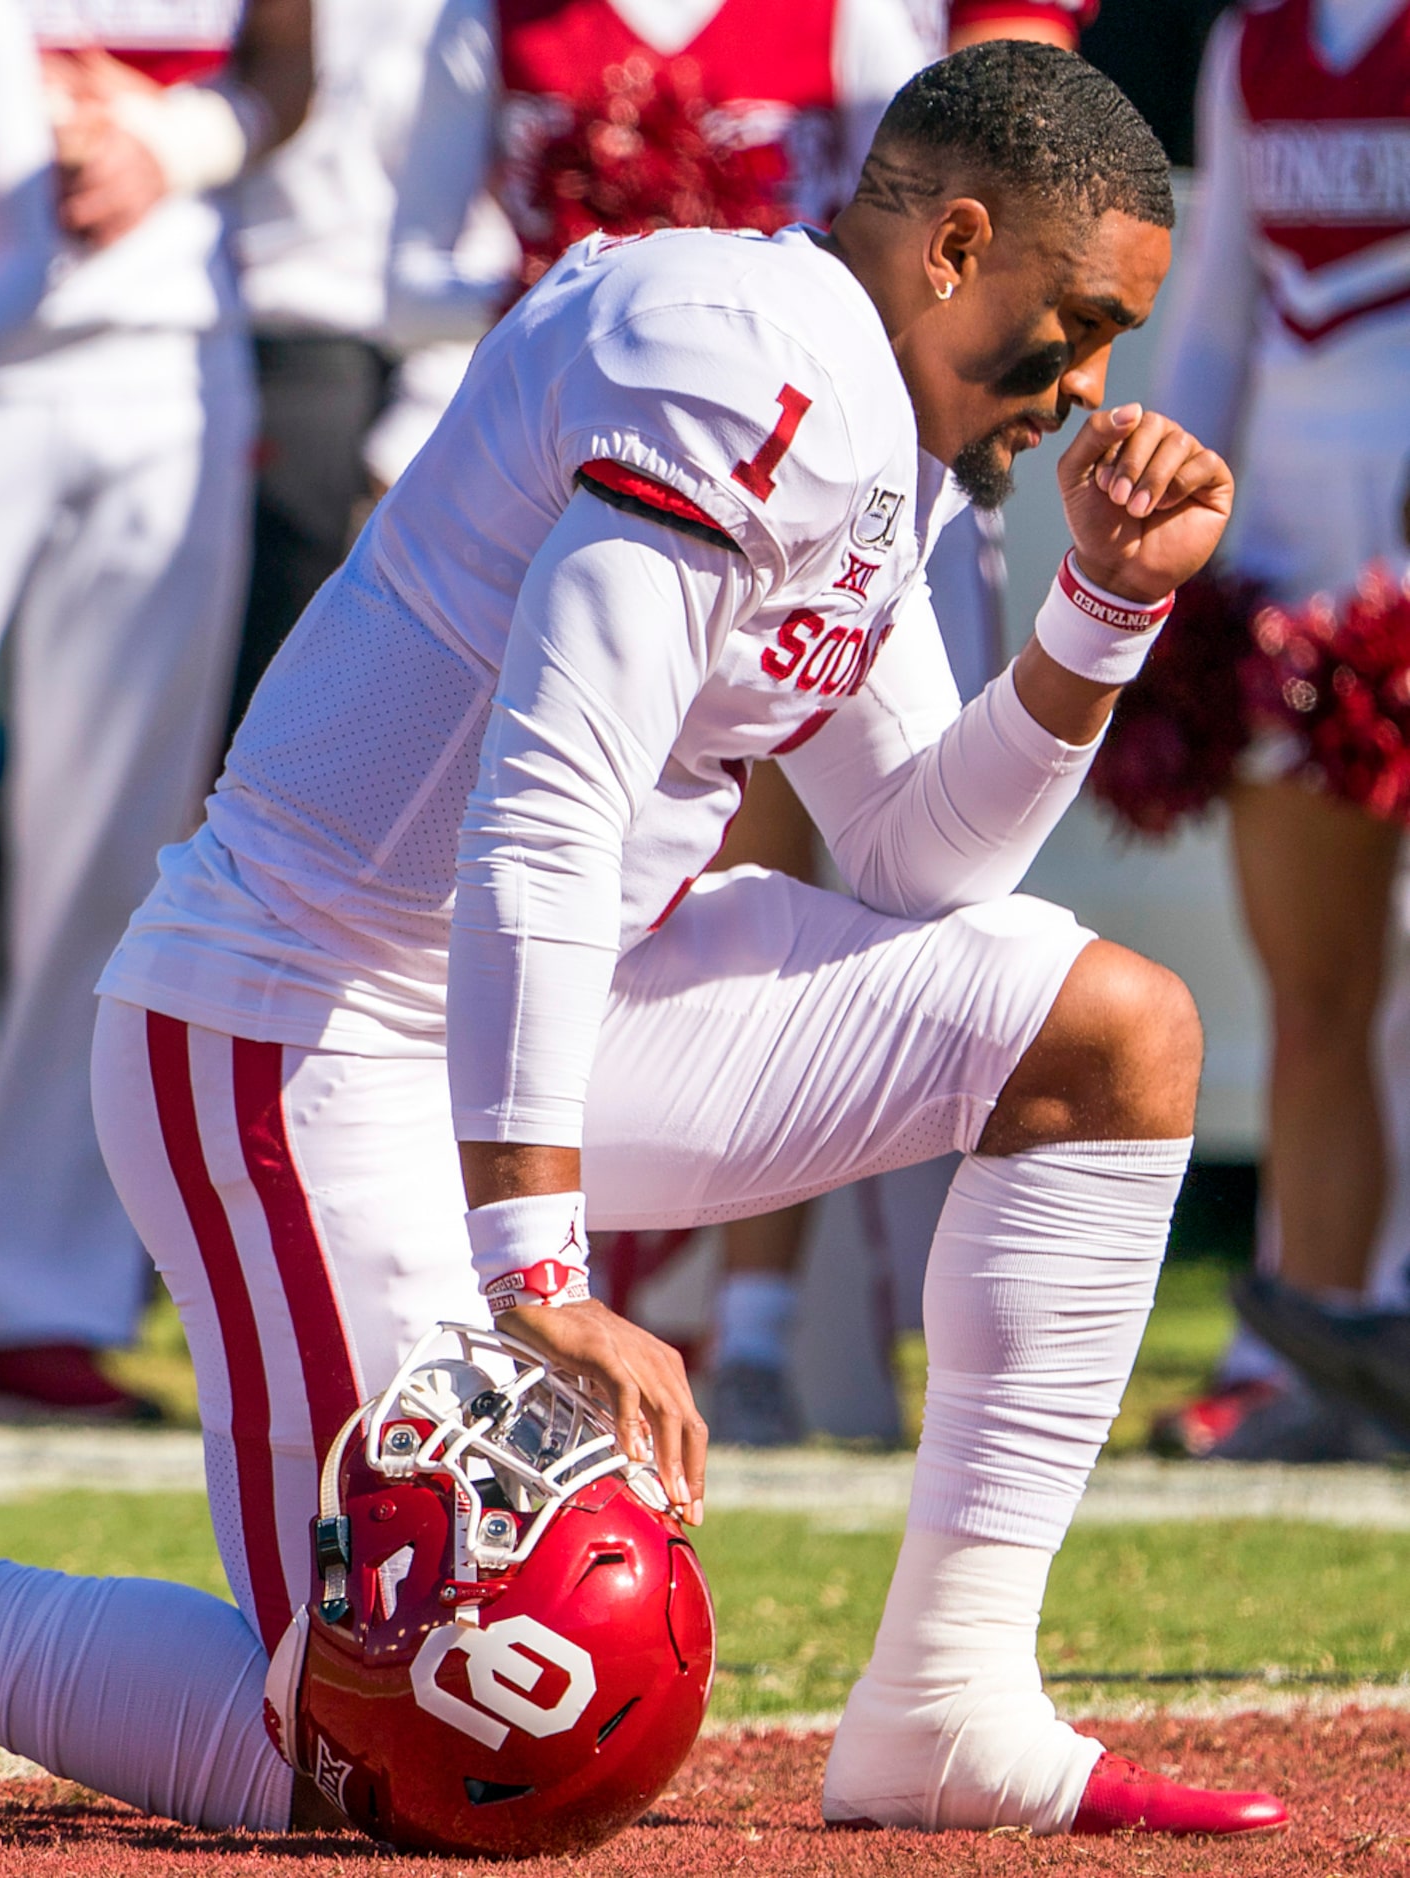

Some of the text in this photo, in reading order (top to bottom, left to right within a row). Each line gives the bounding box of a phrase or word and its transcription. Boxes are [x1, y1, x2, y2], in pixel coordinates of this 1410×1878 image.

[730, 382, 813, 504] 1
[1072, 589, 1152, 627] UNTAMED
[544, 1262, 558, 1292] 1
[408, 1613, 598, 1752] OU
